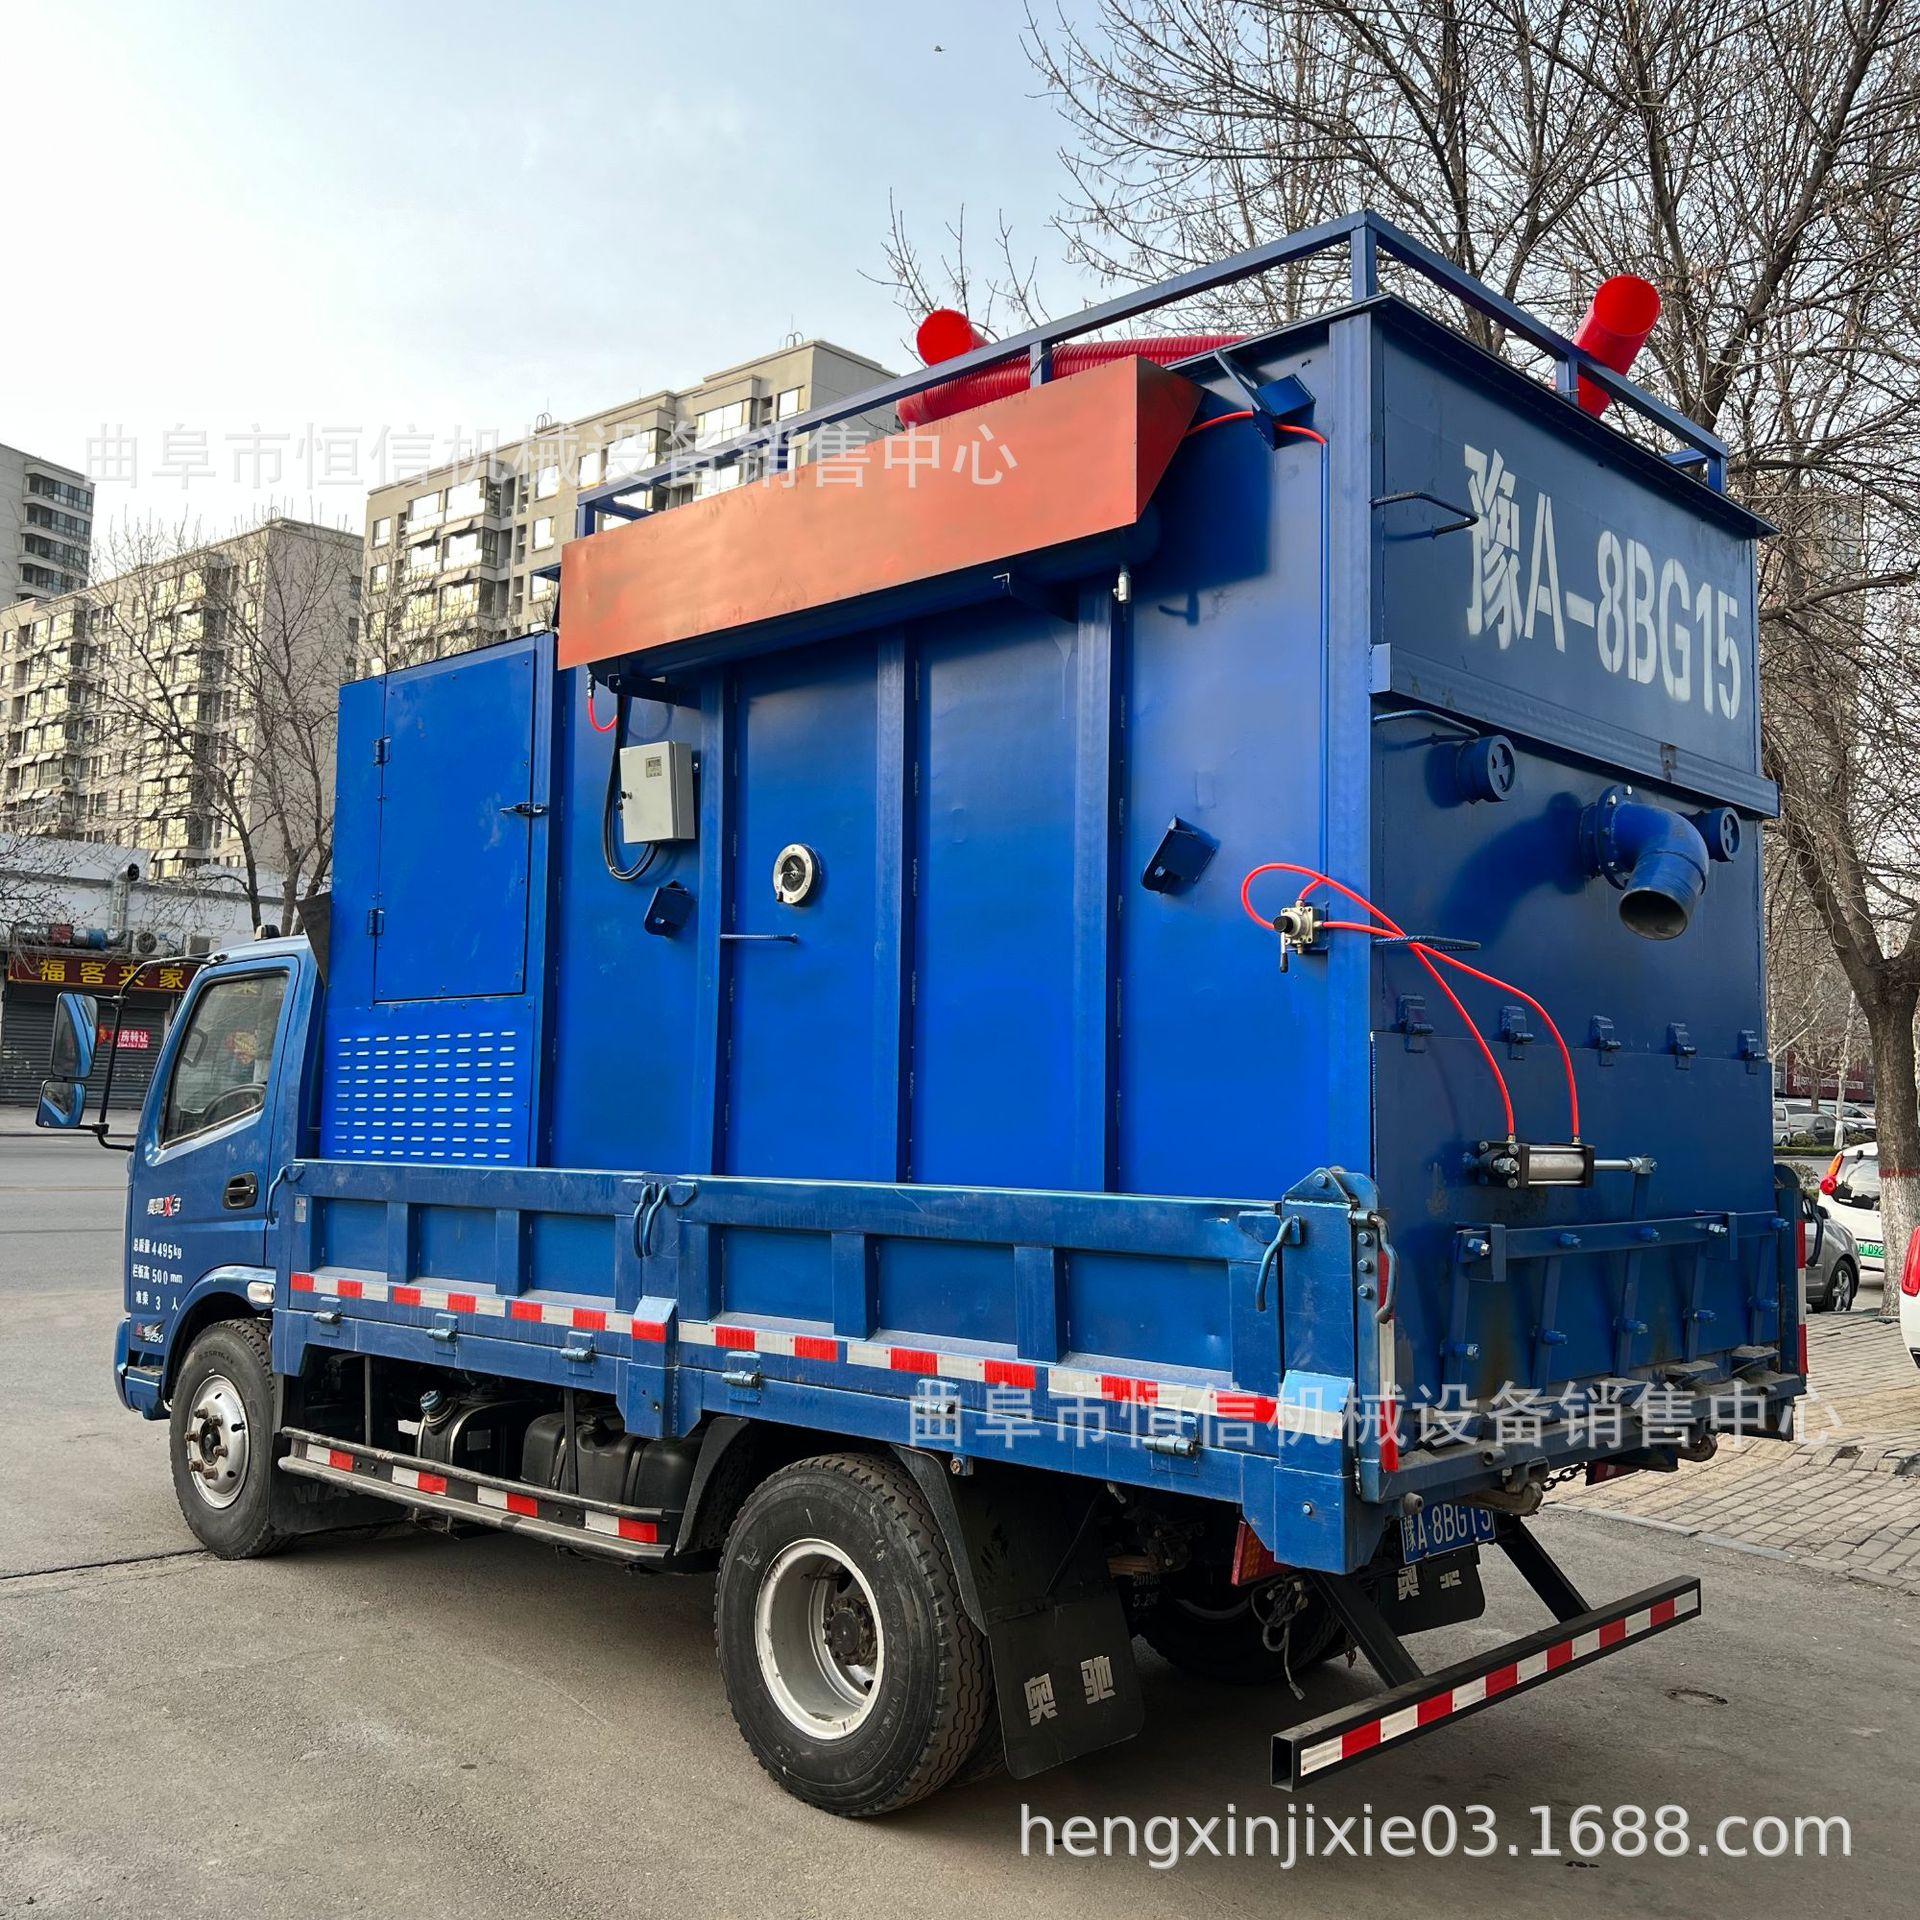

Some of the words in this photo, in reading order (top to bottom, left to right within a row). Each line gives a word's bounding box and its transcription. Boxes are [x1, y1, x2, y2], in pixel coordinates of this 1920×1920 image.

[1464, 444, 1742, 720] 豫A-8BG15
[117, 1029, 149, 1043] 房转让
